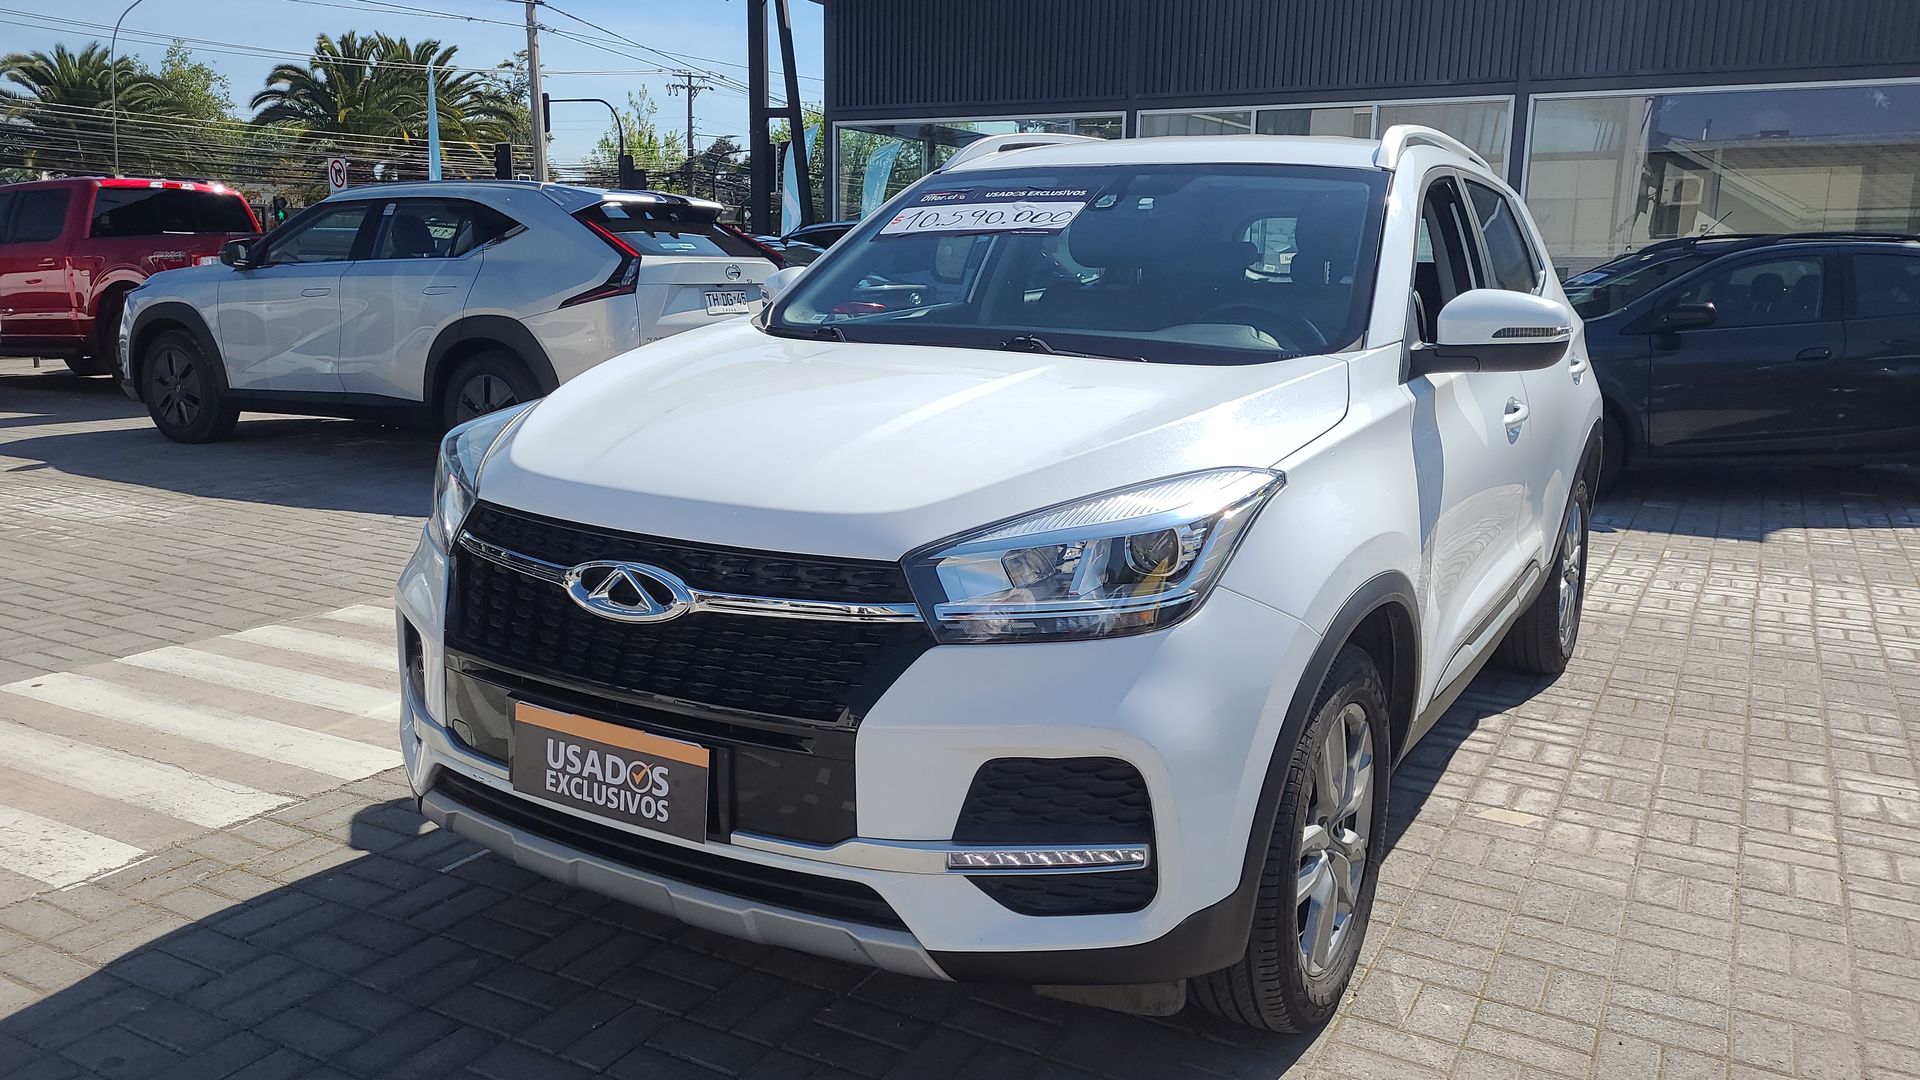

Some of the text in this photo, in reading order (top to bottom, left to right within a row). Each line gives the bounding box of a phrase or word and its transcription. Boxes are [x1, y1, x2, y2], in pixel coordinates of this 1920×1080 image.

[985, 190, 1027, 198] USADOS
[546, 738, 670, 798] USADOS
[545, 769, 670, 823] EXCLUSIVOS
